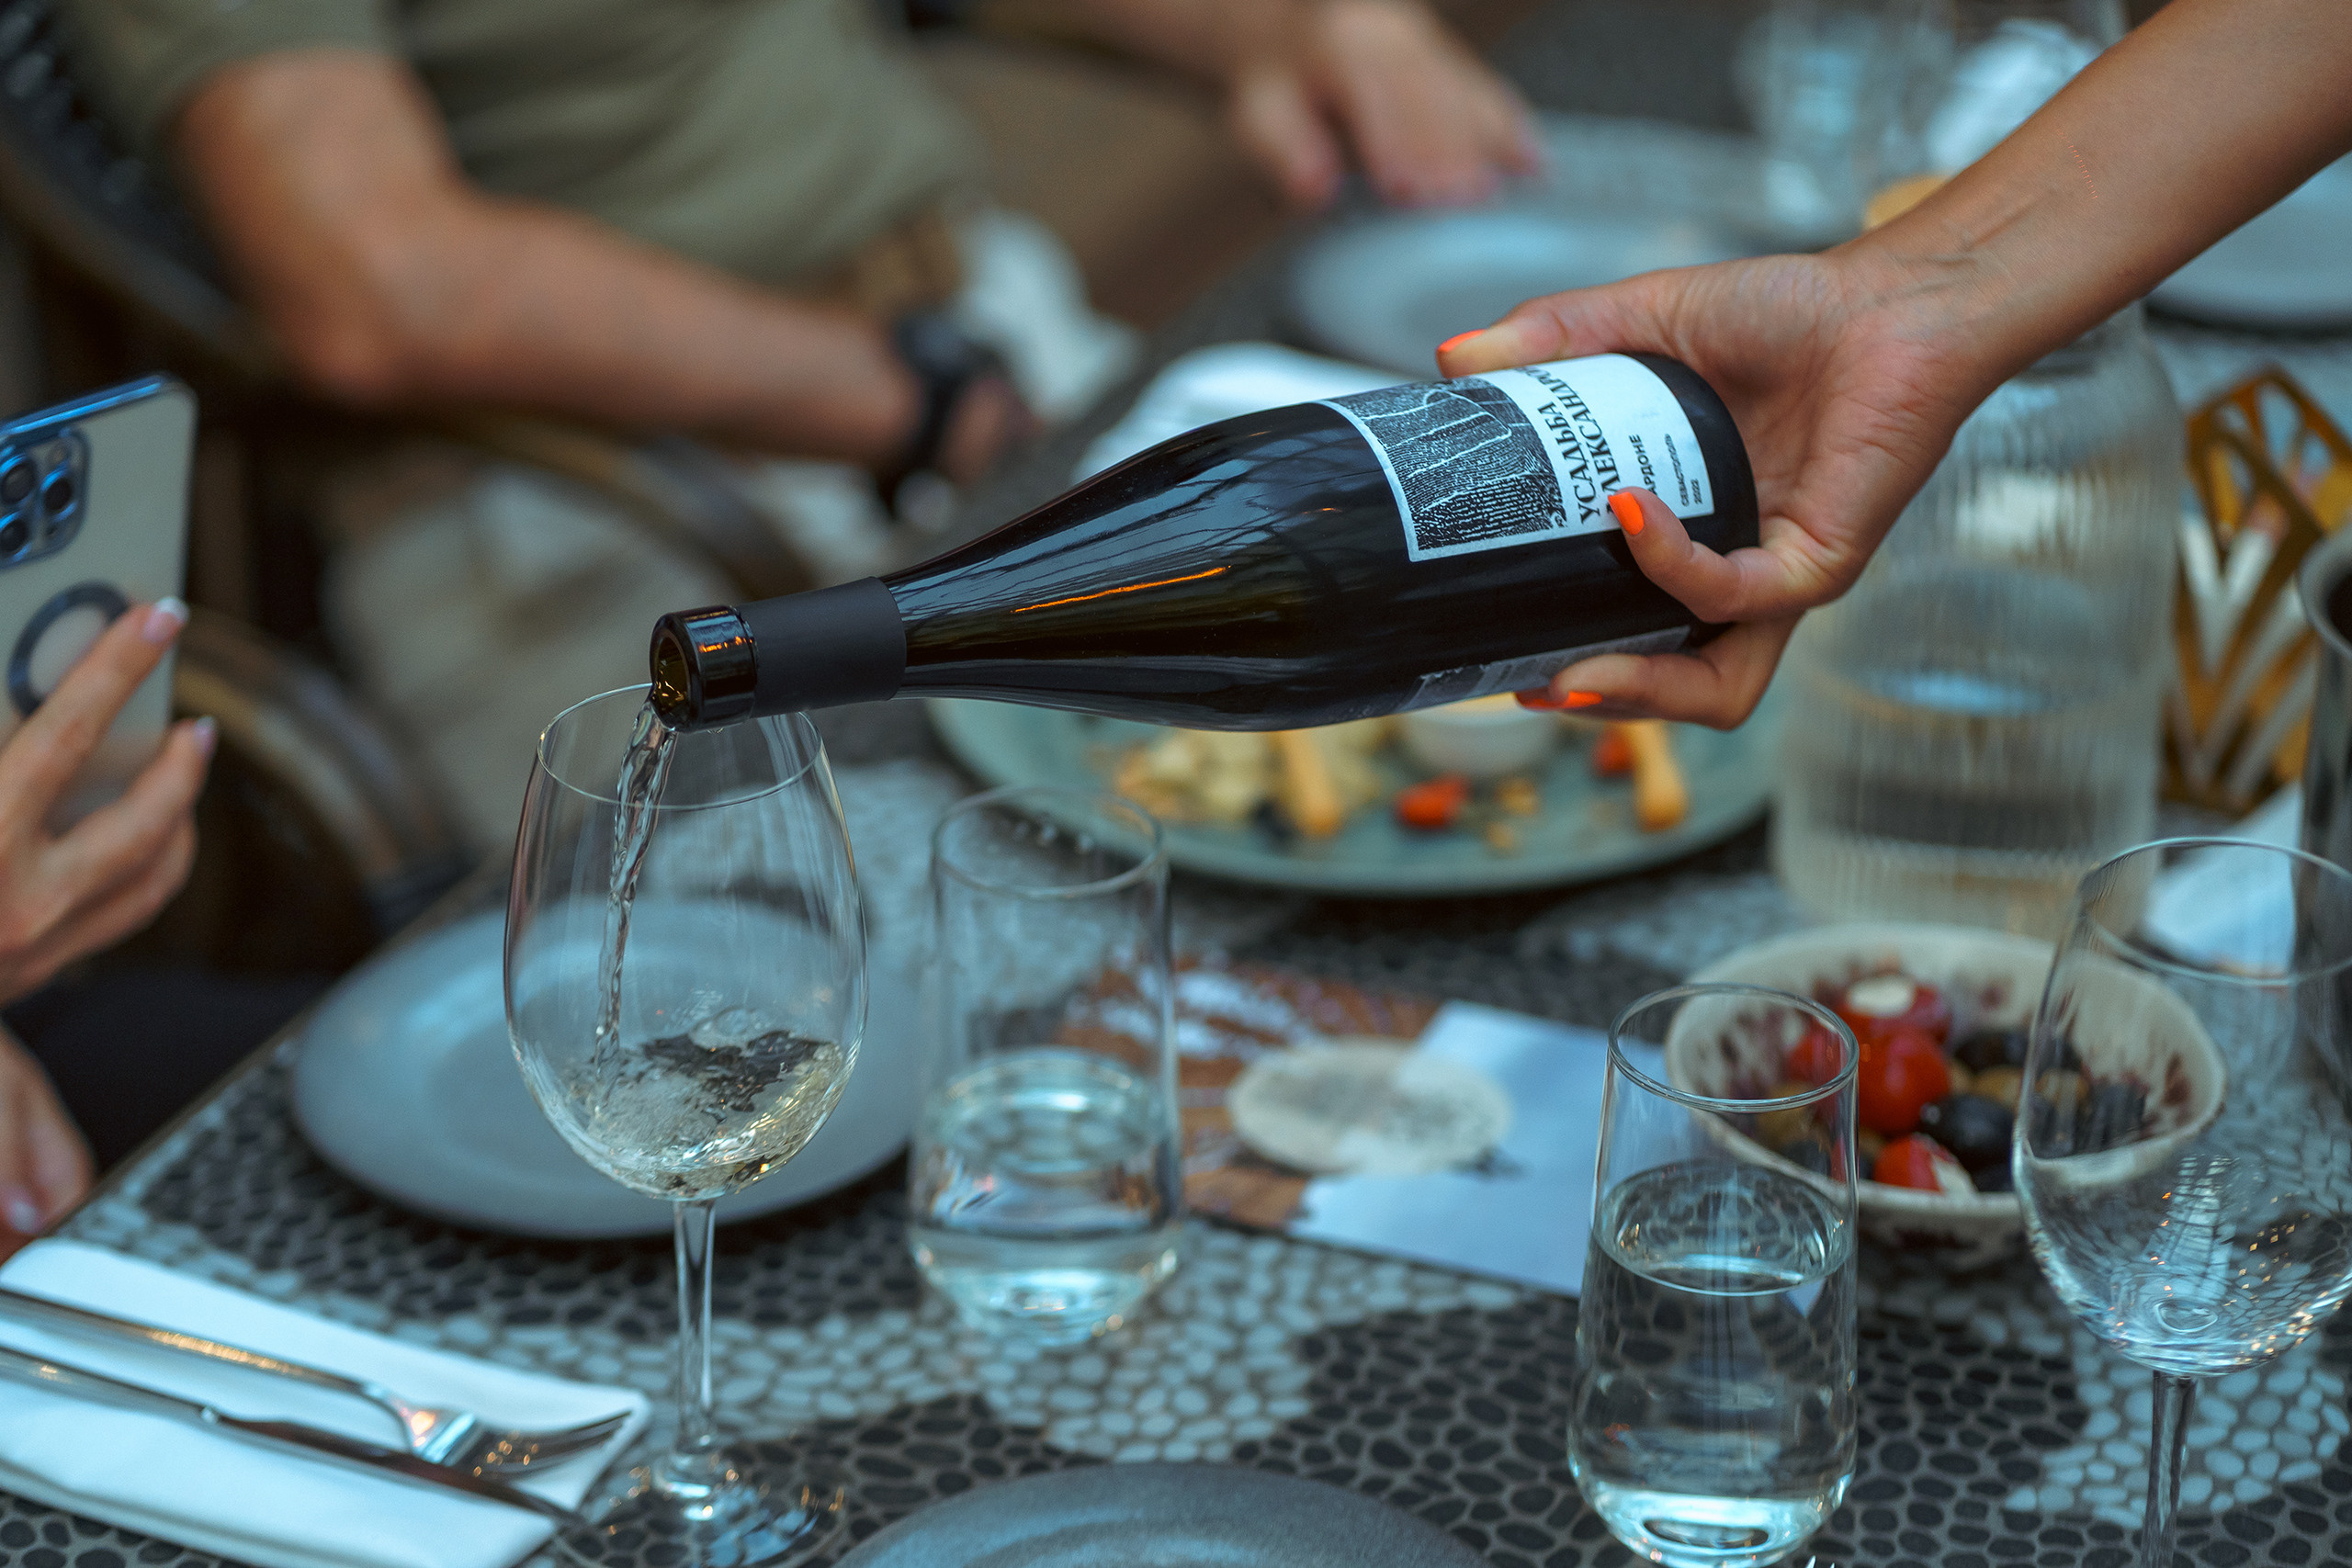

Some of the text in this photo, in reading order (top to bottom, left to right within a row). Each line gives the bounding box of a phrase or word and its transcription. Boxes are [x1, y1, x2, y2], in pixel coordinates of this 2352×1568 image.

[1518, 367, 1621, 514] ЛЕКСАНДРО
[1537, 401, 1600, 525] УСАДЬБА
[1629, 434, 1657, 497] АРДОНЕ
